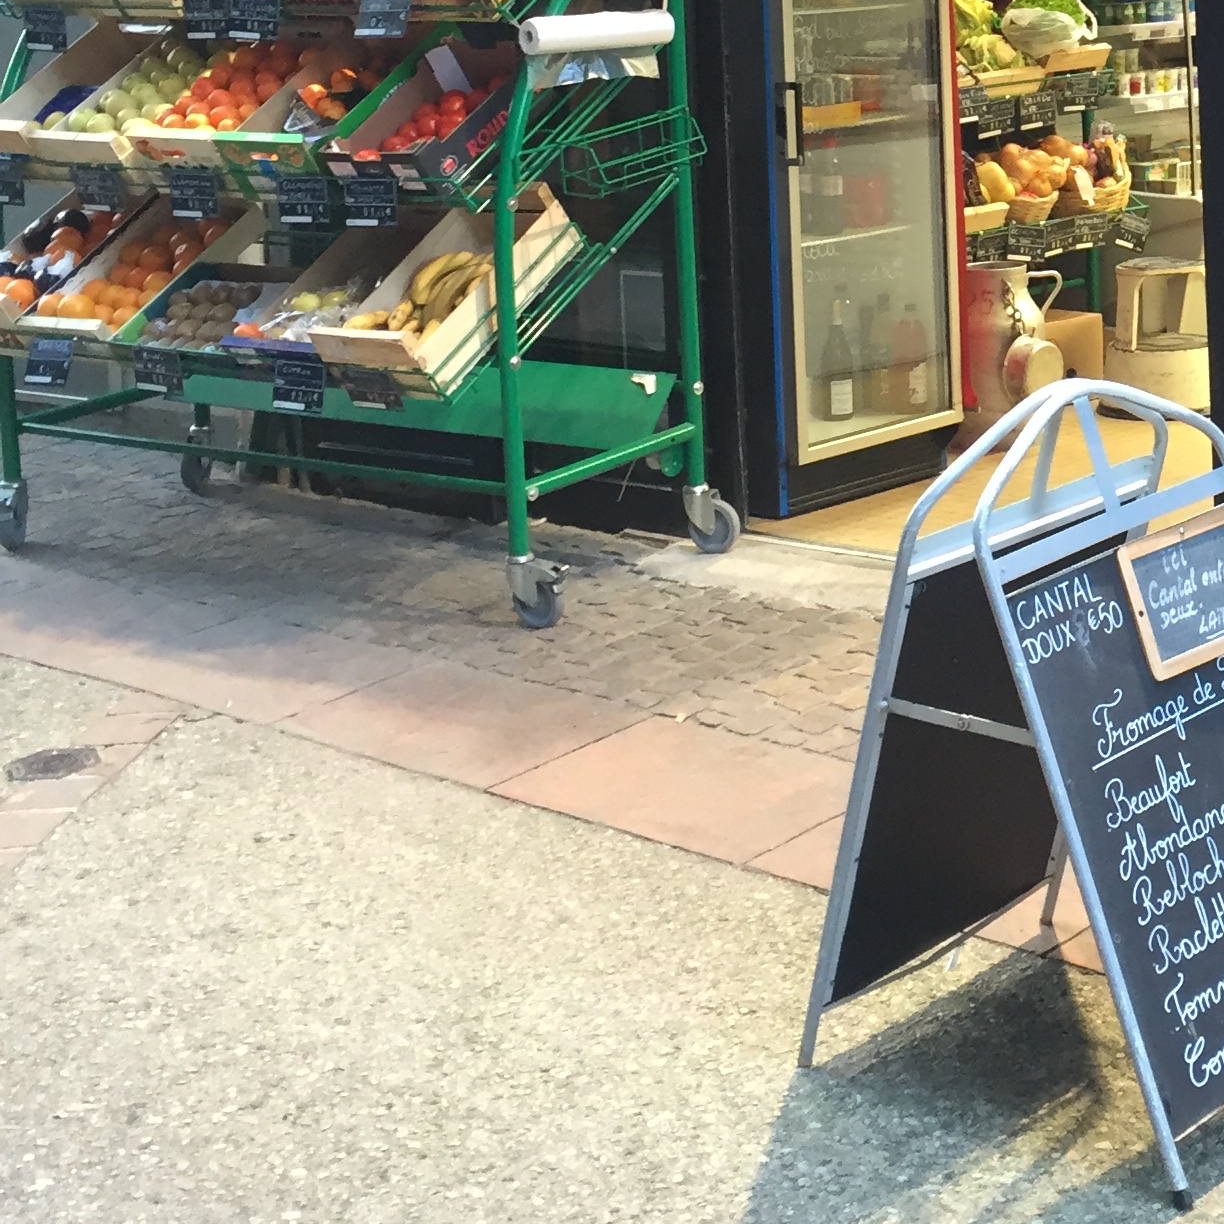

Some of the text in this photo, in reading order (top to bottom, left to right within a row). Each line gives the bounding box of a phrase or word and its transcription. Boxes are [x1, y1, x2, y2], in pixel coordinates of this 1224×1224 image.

[1016, 573, 1103, 630] CANTAL
[1148, 566, 1198, 610] Cantal
[1022, 620, 1076, 664] DOUX
[1092, 688, 1189, 758] Fromage
[1193, 673, 1216, 705] de
[1104, 752, 1196, 829] Beaufort
